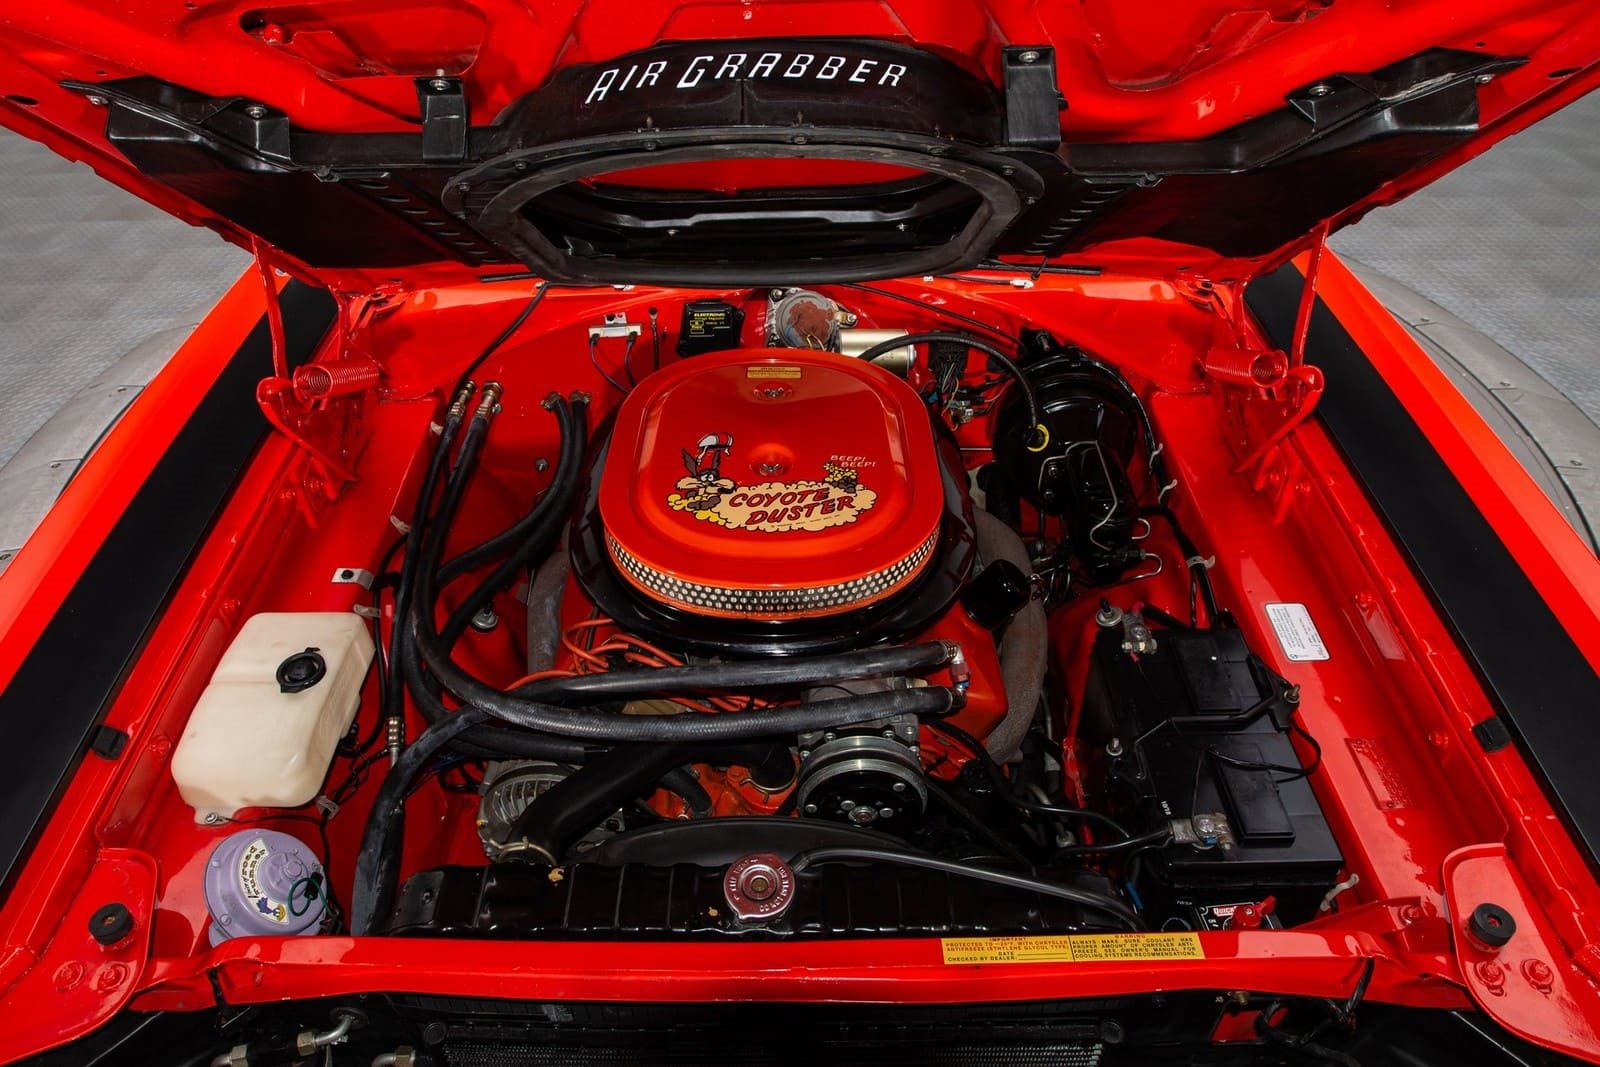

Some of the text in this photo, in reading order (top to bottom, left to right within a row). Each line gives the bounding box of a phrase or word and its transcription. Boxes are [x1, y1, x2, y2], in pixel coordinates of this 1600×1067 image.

[584, 52, 907, 105] AIR GRABBER
[729, 487, 831, 508] COYOTE
[745, 495, 856, 526] DUSTER
